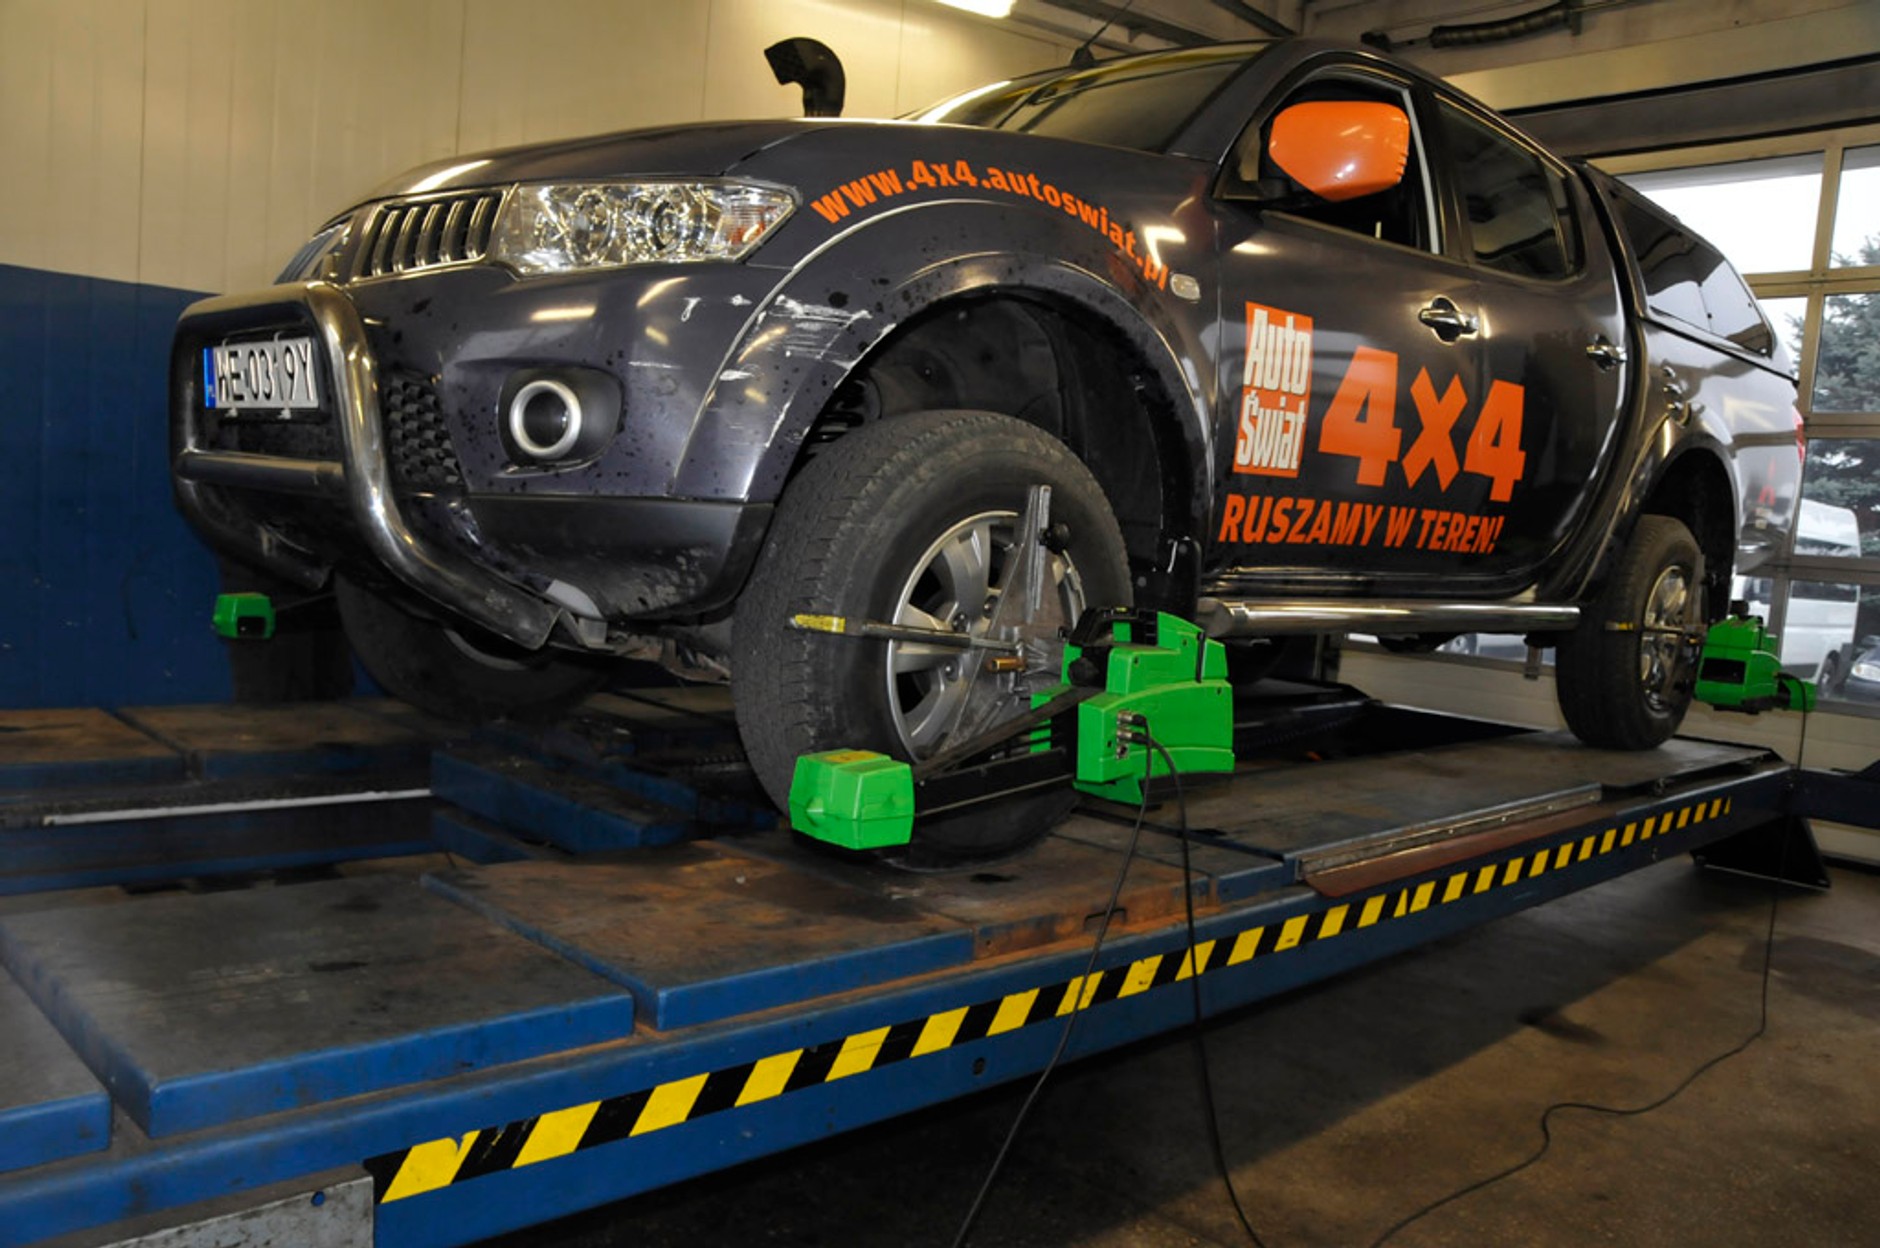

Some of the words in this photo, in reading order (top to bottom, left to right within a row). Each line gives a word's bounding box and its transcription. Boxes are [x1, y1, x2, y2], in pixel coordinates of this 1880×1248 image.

[810, 160, 1169, 291] www.4x4.autoswiat.pl
[1243, 308, 1311, 395] Auto
[1236, 389, 1306, 470] Świat
[1218, 494, 1383, 547] RUSZAMY
[1383, 506, 1417, 548] W
[1415, 508, 1505, 555] TEREN!
